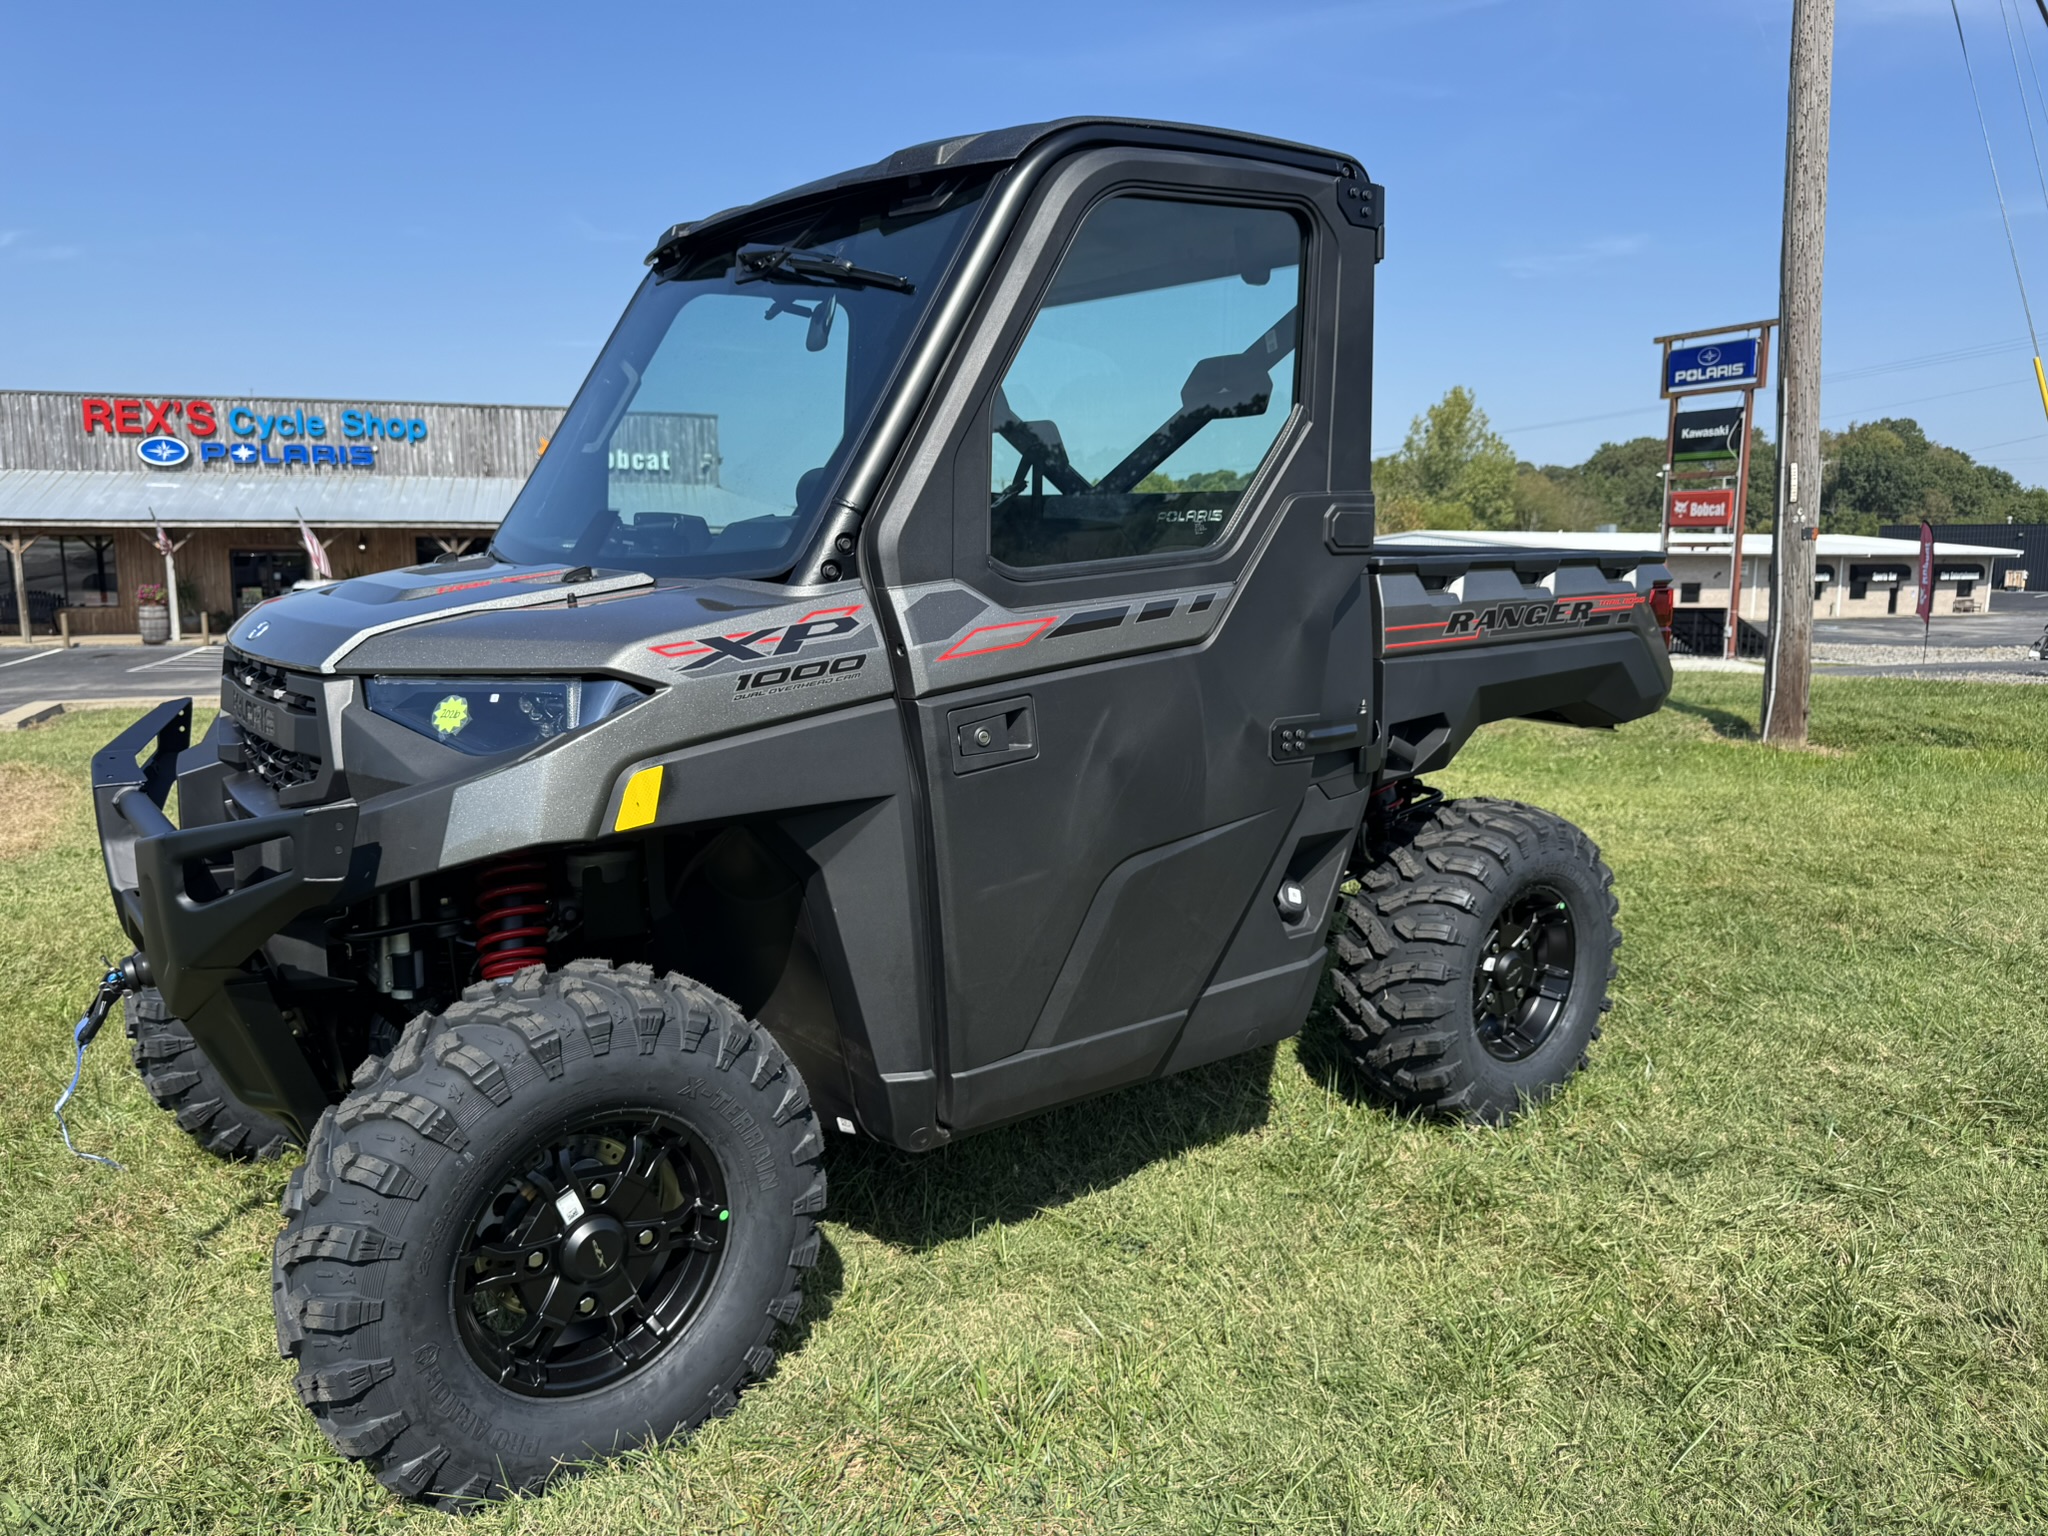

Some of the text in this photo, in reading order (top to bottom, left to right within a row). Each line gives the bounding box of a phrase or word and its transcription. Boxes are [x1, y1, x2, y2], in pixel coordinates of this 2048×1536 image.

[1674, 362, 1744, 383] POLARIS
[81, 398, 427, 443] REX'S Cycle Shop
[1681, 425, 1729, 439] Kawasaki
[201, 442, 375, 466] POLARIS
[1157, 510, 1223, 522] POLARIS
[1690, 502, 1726, 517] Bobcat
[1443, 601, 1593, 635] RANGER
[674, 616, 860, 672] XP
[733, 672, 861, 701] DUAL OVERHEAD CAM
[735, 653, 867, 691] 1000
[677, 1077, 780, 1193] X-TERRAIN
[424, 1364, 542, 1458] PRO ARMOR
